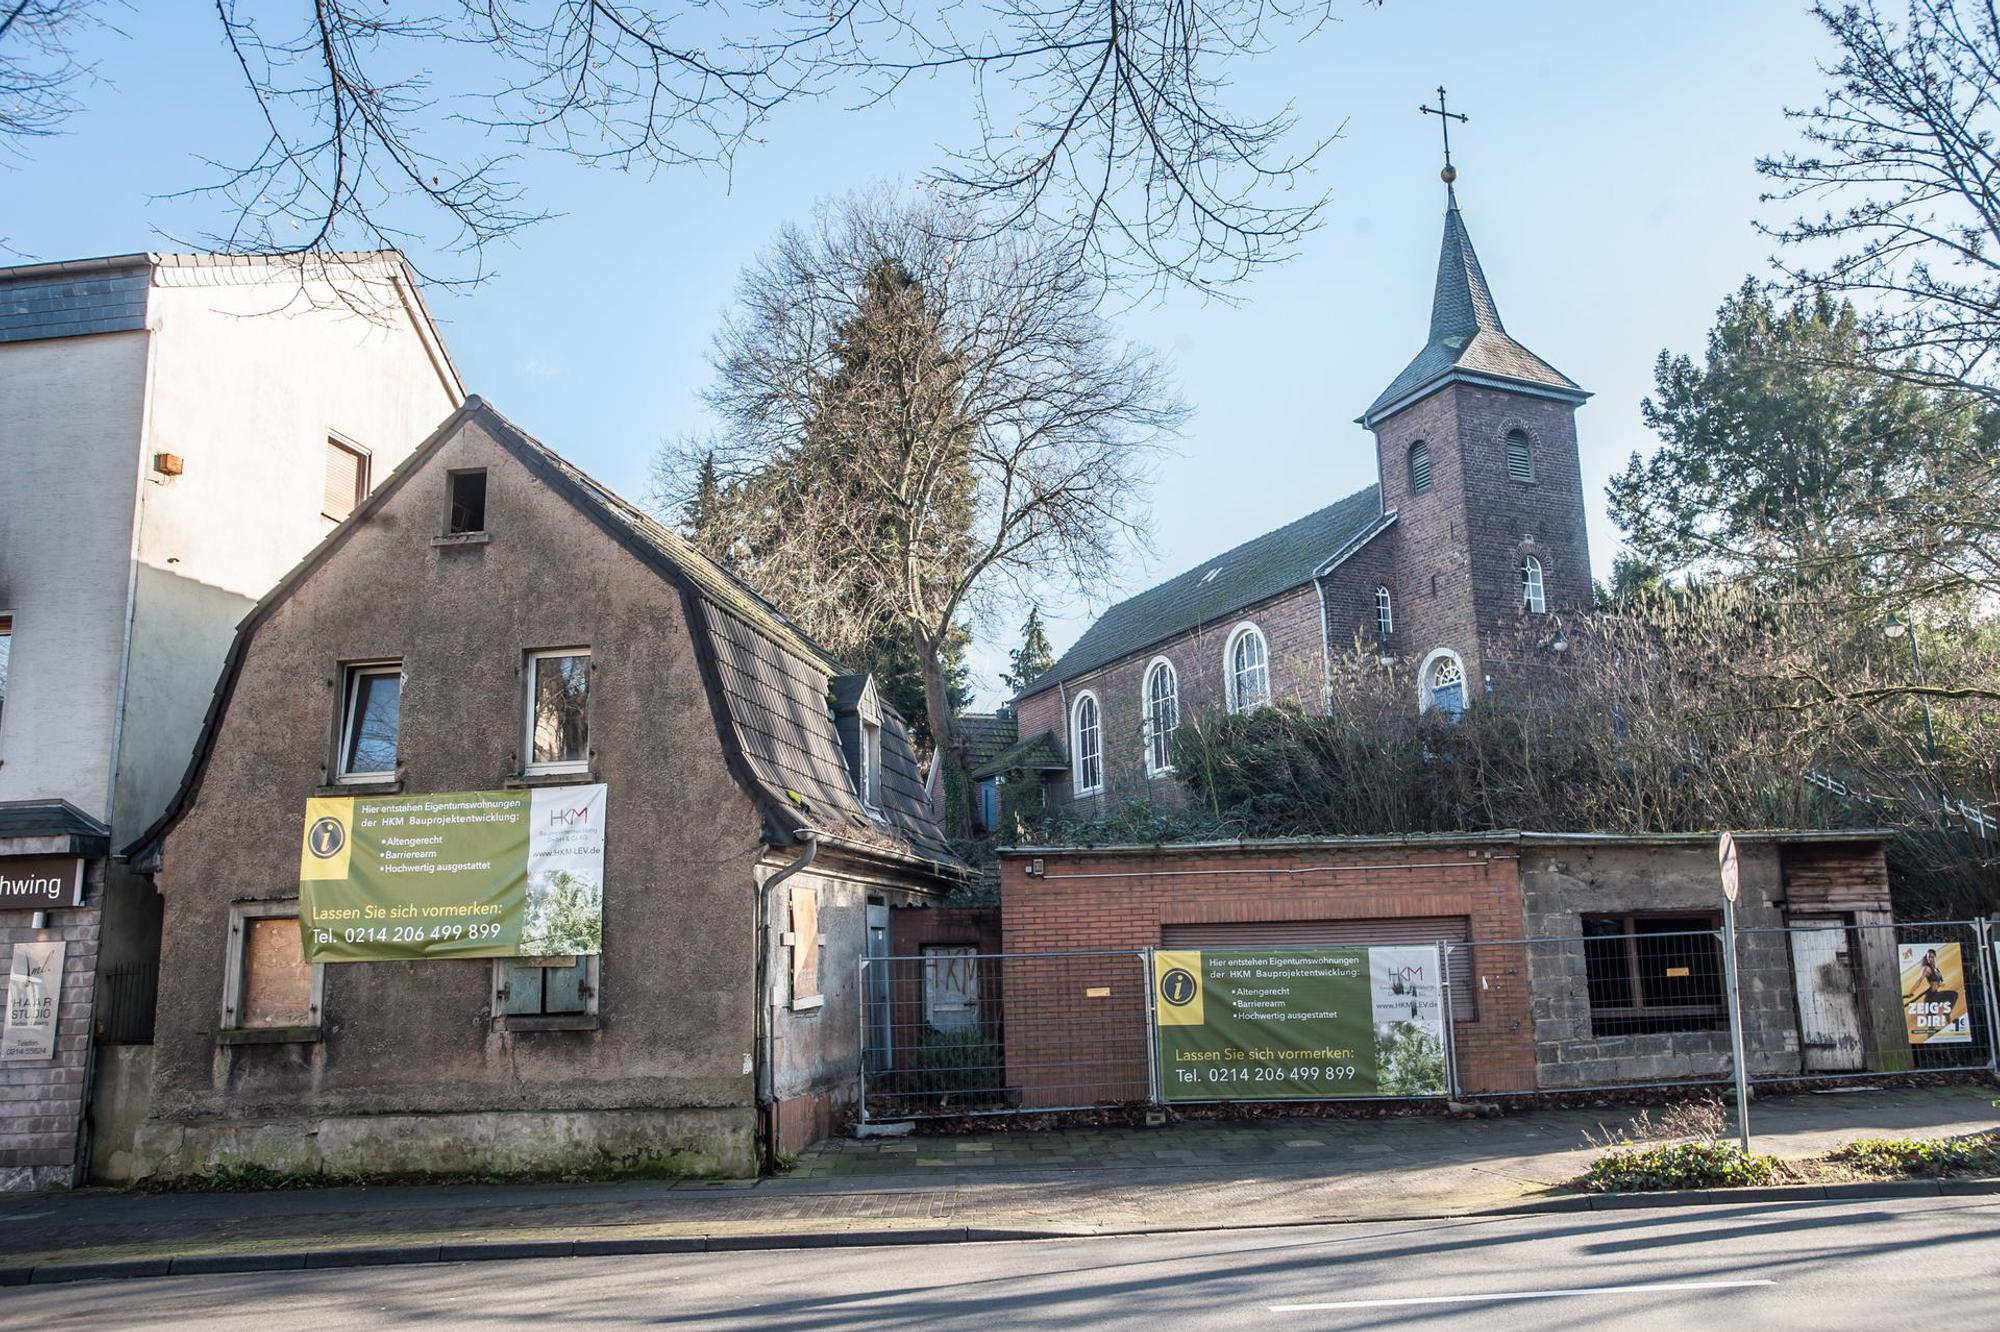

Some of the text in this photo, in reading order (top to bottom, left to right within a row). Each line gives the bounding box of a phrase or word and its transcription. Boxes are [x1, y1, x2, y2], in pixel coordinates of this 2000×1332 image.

[361, 799, 521, 814] Hier entstehen Eigentumswohnungen
[361, 812, 520, 827] der HKM Bauprojektentwicklung:
[550, 807, 588, 826] HKM
[386, 834, 443, 848] Altengerecht
[385, 850, 437, 859] Barrierearm
[385, 861, 491, 874] Hochwertig ausgestattet
[312, 900, 503, 921] Lassen Sie sich vormerken:
[312, 922, 501, 944] Tel. 0214 206 499 899
[1208, 956, 1360, 968] Hier entstehen Eigentumswohnungen
[1210, 968, 1361, 980] der HKM Bauprojektentwicklung:
[1388, 966, 1423, 982] HKM
[1236, 987, 1290, 998] Altengerecht
[1237, 1000, 1286, 1008] Barrierearm
[1908, 1001, 1952, 1015] ZEIG'S
[1238, 1011, 1338, 1022] Hochwertig ausgestattet
[1175, 1046, 1355, 1062] Lassen Sie sich vormerken:
[1175, 1066, 1355, 1083] Tel. 0214 206 499 899
